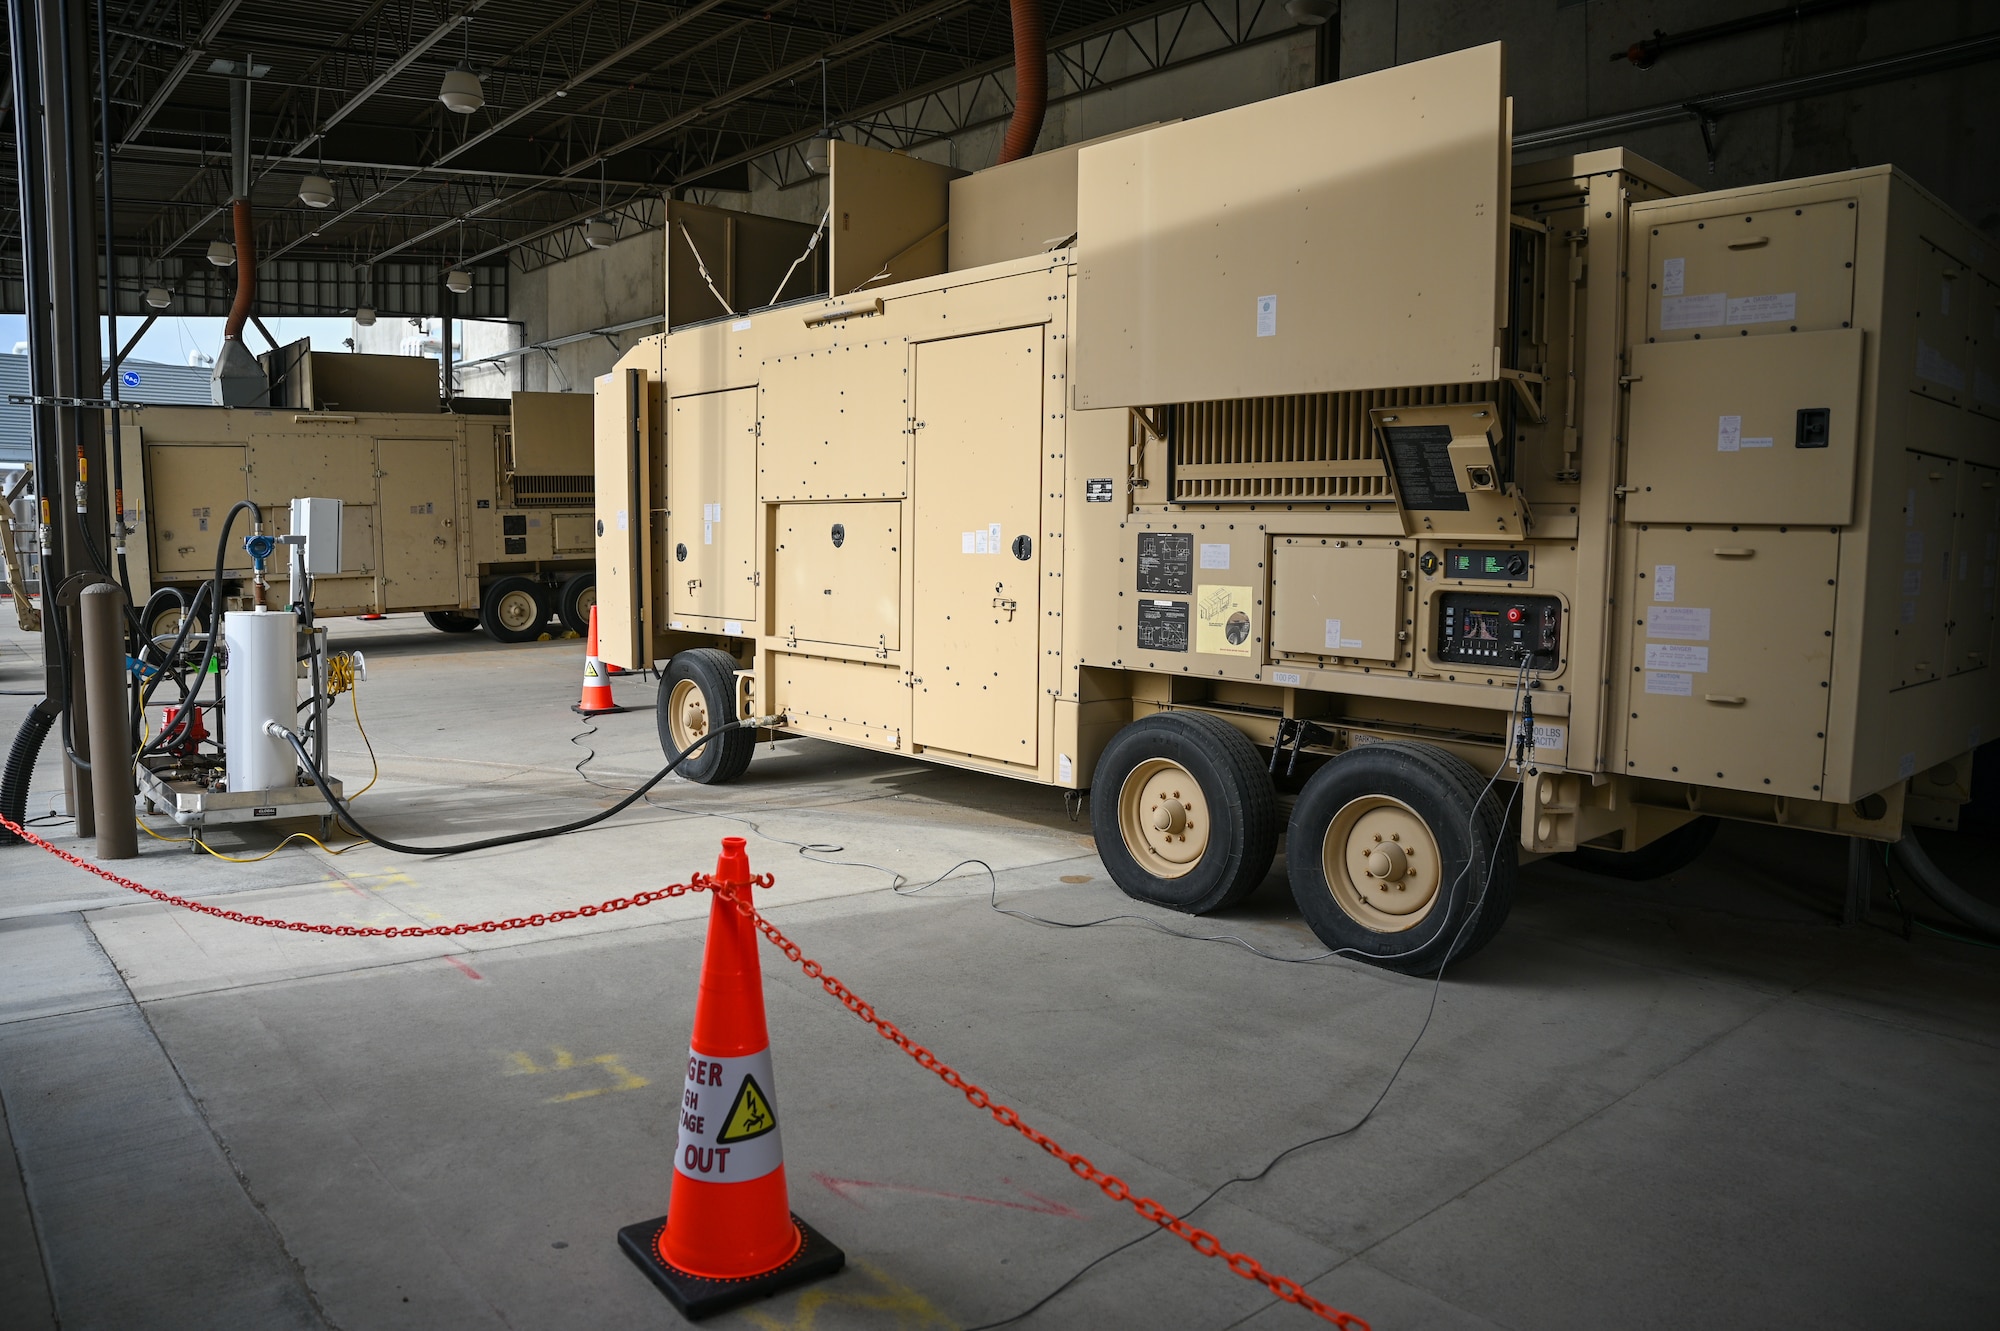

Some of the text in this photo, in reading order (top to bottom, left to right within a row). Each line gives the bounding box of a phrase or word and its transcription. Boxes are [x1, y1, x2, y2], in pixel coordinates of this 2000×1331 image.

[1752, 295, 1778, 304] DANGER
[1669, 645, 1692, 653] DANGER
[1276, 673, 1298, 683] 100 PSI
[1656, 672, 1680, 680] CAUTION
[1545, 727, 1561, 738] LBS
[684, 1144, 731, 1173] OUT
